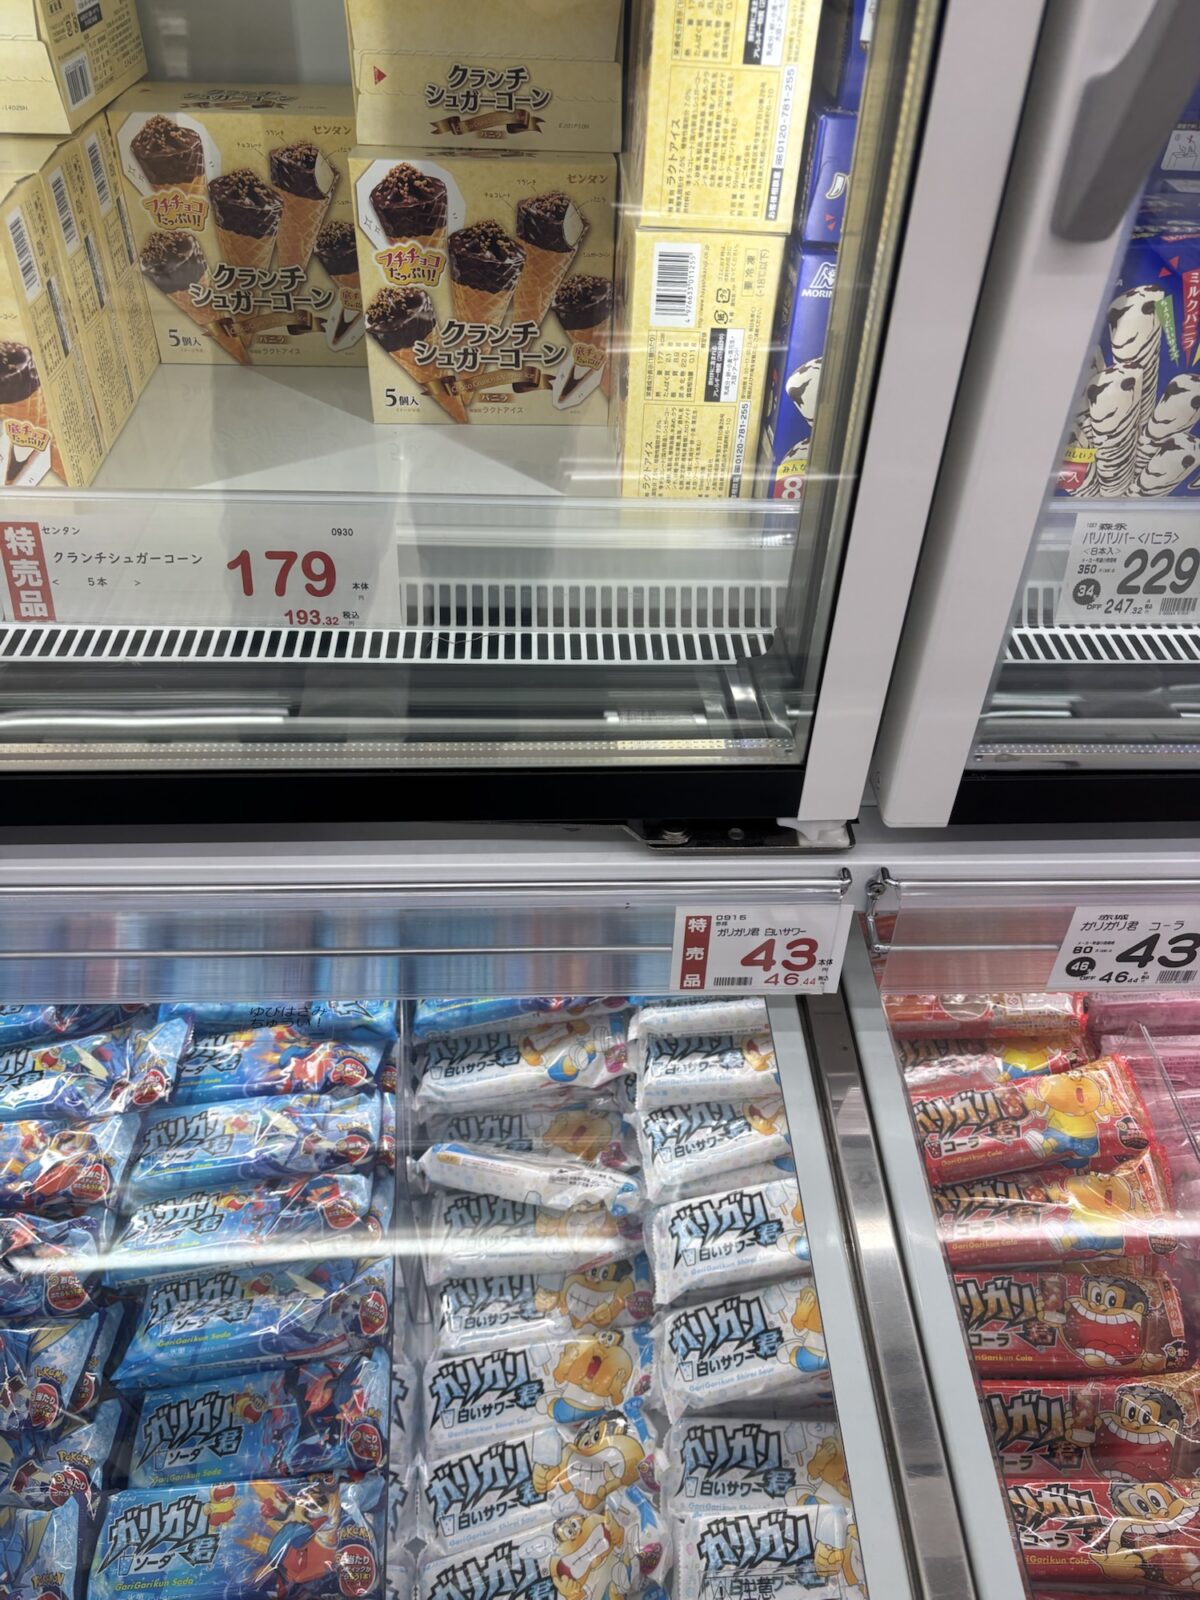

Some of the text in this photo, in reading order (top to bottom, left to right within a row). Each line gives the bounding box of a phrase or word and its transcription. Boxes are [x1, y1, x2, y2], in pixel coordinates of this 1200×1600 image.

[449, 65, 528, 90] クランチ
[426, 84, 552, 112] シュガーコーン
[776, 67, 794, 153] 0120-781-255
[313, 125, 351, 136] センタン
[666, 118, 680, 185] ラクトアイス
[567, 173, 608, 184] センタン
[214, 264, 305, 290] クランチ
[189, 283, 333, 314] シュガーコーン
[1185, 272, 1200, 350] ミルクバニラ
[441, 320, 540, 347] クランチ
[413, 341, 566, 372] シュガーコーン
[384, 388, 419, 407] 5個入
[736, 403, 748, 463] 0120-781-255
[782, 477, 803, 499] 8
[41, 526, 81, 536] センタン
[331, 528, 354, 537] 0930
[53, 552, 204, 566] クランチシュガーコーン
[4, 525, 49, 619] 特売品
[226, 549, 337, 598] 179
[1116, 547, 1200, 595] 229
[88, 577, 108, 587] 5本
[352, 582, 369, 592] 本体
[284, 609, 340, 627] 193.32
[343, 609, 360, 620] 税込
[717, 927, 807, 937] ガリガリ君 白いサワー
[1080, 920, 1185, 932] ガリガリ君 コーラ
[683, 918, 708, 988] 特売品
[740, 937, 819, 973] 43
[1072, 946, 1094, 954] 80
[1115, 933, 1200, 968] 43
[764, 973, 816, 986] 46.44
[249, 1006, 327, 1018] ゆびはさみ
[250, 1017, 322, 1029] ちゅうい!
[444, 1060, 496, 1078] 白いサワー
[138, 1110, 234, 1161] ガリガリ君
[674, 1134, 725, 1158] 白いサワー
[943, 1135, 980, 1153] コーラ
[166, 1151, 194, 1161] ソーダ
[668, 1190, 785, 1269] ガリガリ君
[956, 1220, 996, 1236] コーラ
[699, 1240, 756, 1261] 白いサワー
[143, 1272, 253, 1336] ガリガリ君
[176, 1318, 210, 1330] ソーダ
[463, 1312, 520, 1330] 白いサワー
[668, 1296, 785, 1380] ガリガリ君
[970, 1332, 1011, 1347] コーラ
[696, 1352, 755, 1378] 白いサワー
[428, 1349, 545, 1431] ガリガリ君
[457, 1402, 515, 1424] 白いサワー
[136, 1390, 243, 1470] ガリガリ君
[168, 1446, 205, 1465] ソーダ
[675, 1423, 797, 1499] ガリガリ君
[699, 1480, 764, 1499] 白いサワー
[458, 1503, 518, 1531] 白いサワー
[96, 1494, 220, 1574] ガリガリ君
[134, 1552, 176, 1572] ソーダ
[1069, 1557, 1090, 1566] Cola
[114, 1578, 170, 1592] GariGarikun
